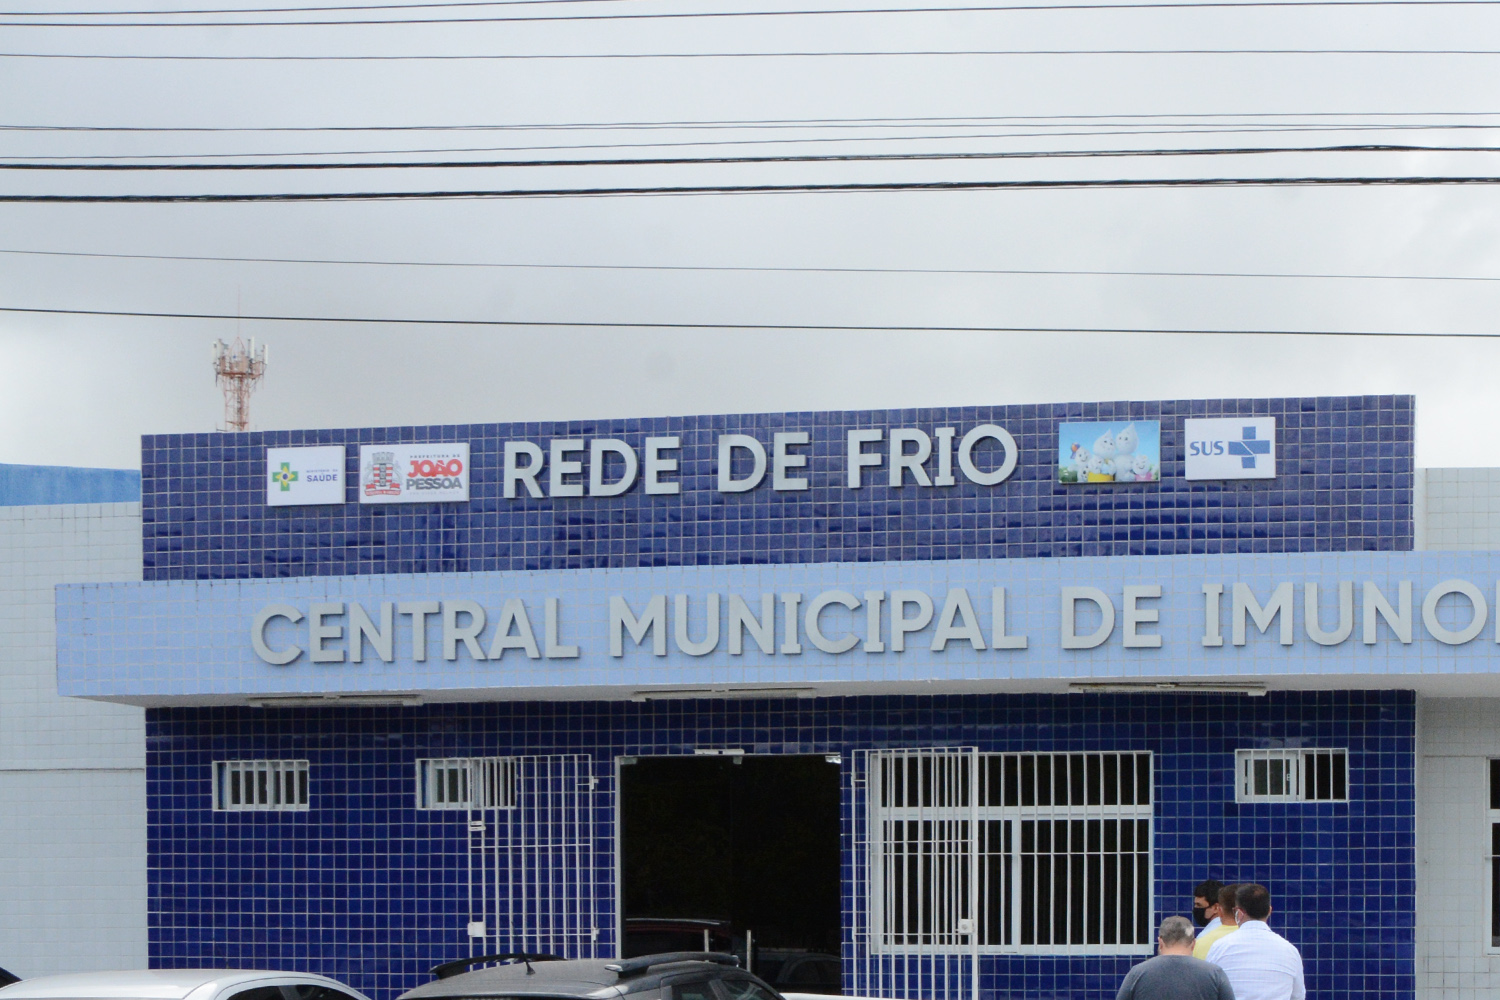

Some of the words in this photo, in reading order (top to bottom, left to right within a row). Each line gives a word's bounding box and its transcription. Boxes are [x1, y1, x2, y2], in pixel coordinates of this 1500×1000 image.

[1190, 440, 1224, 456] SUS
[407, 458, 463, 478] JOÃO
[503, 436, 681, 498] REDE
[718, 432, 808, 493] DE
[847, 424, 1018, 488] FRIO
[306, 472, 338, 482] SAÚDE
[406, 477, 463, 490] PESSOA
[250, 599, 581, 665] CENTRAL
[608, 586, 1028, 656] MUNICIPAL
[1062, 585, 1162, 650] DE
